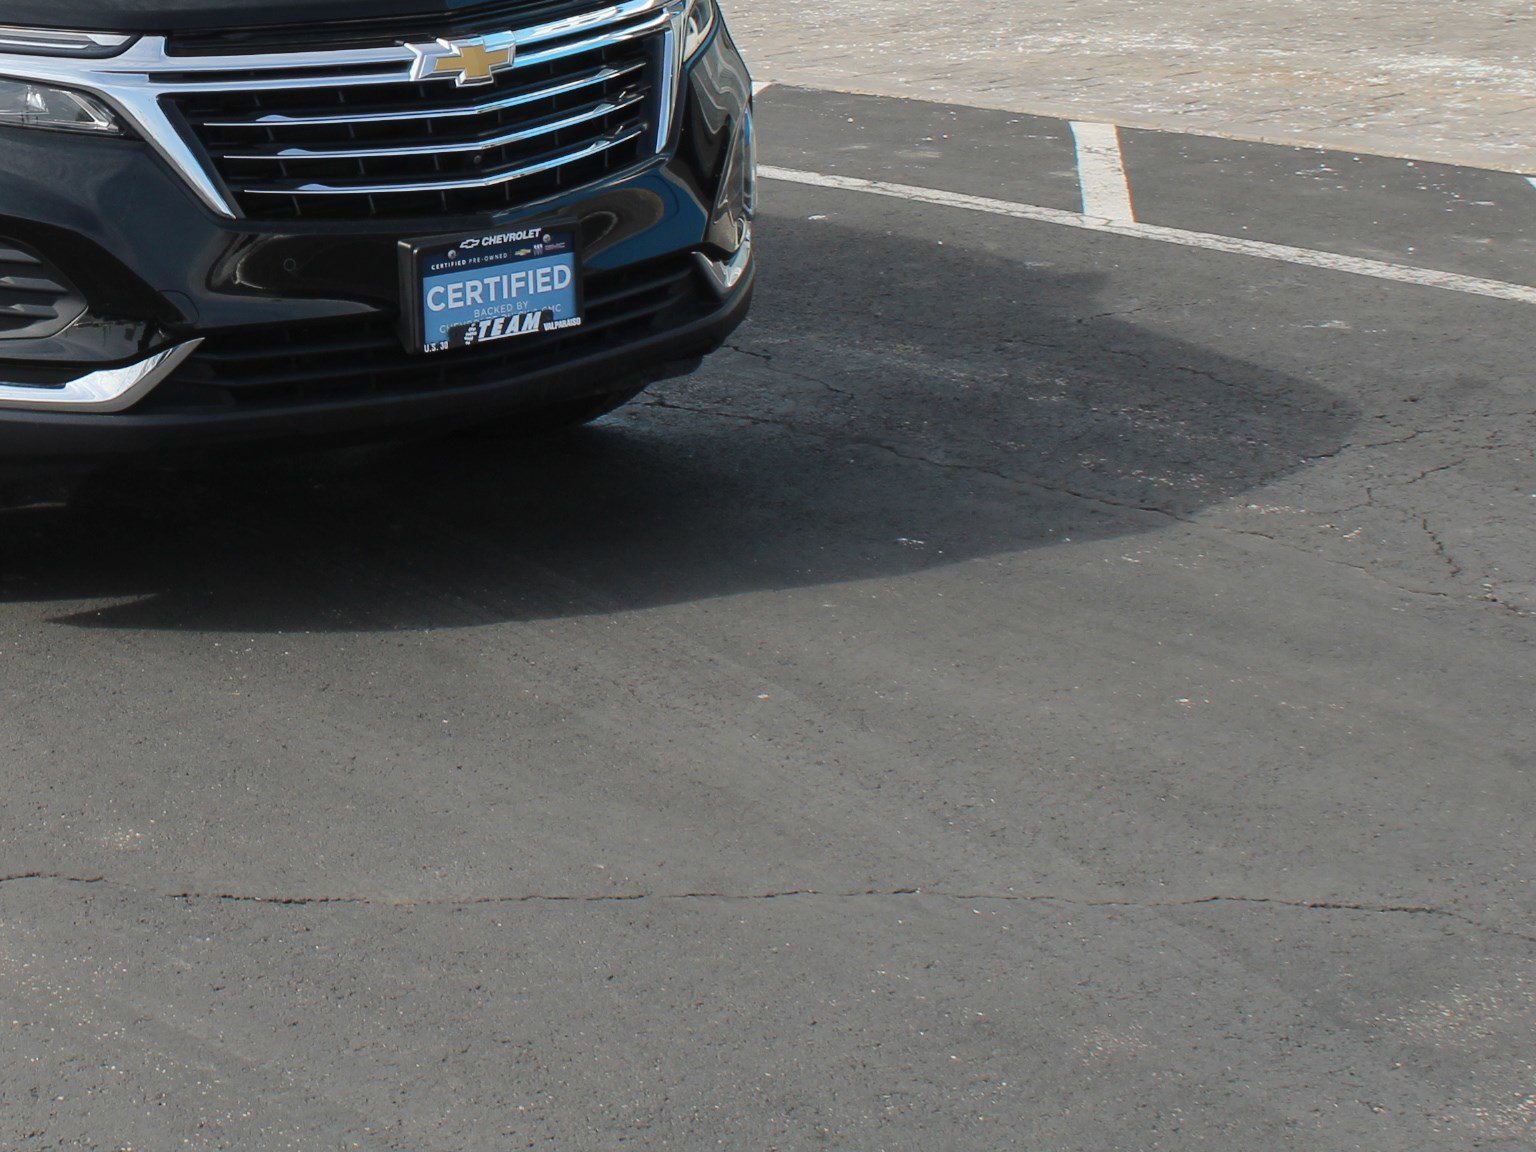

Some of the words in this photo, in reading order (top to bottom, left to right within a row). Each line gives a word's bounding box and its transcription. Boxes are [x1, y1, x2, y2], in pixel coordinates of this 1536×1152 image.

[481, 227, 542, 246] CHEVROLET
[431, 259, 467, 270] CERTIFIED
[468, 253, 508, 264] PRE-OWNED
[426, 264, 572, 312] CERTIFIED
[474, 304, 513, 318] BACKED
[516, 301, 529, 311] BY
[477, 311, 542, 339] TEAM
[423, 342, 439, 353] U.S.
